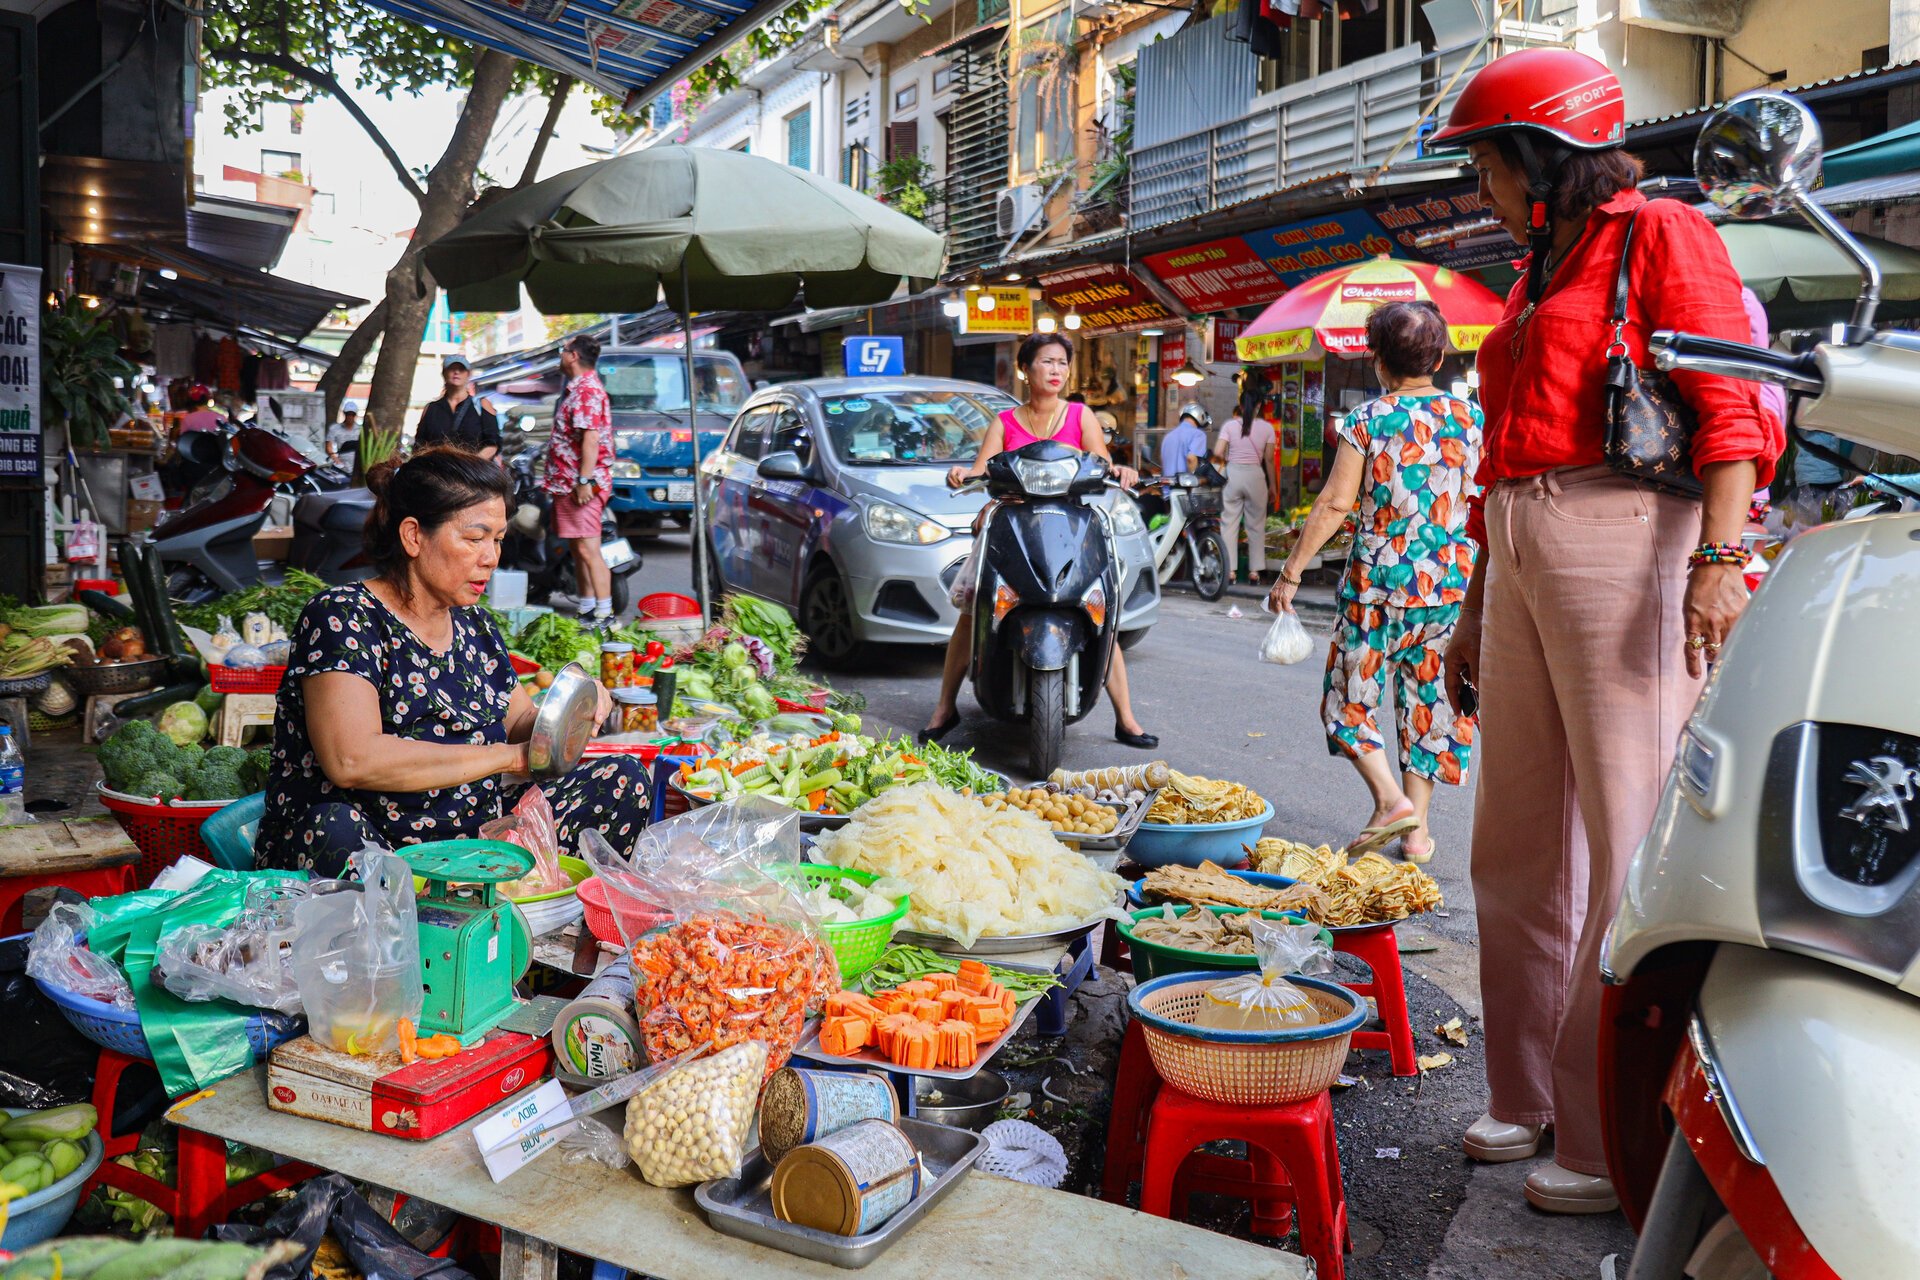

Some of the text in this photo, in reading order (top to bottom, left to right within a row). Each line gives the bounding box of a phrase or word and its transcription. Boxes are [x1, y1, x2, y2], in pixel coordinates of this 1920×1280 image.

[1565, 86, 1606, 111] SPORT
[1305, 221, 1344, 240] LONG
[1266, 255, 1306, 274] HOA
[1329, 242, 1364, 262] CAO
[1189, 270, 1231, 296] QUAY
[1343, 287, 1415, 297] Cholimex
[1325, 334, 1369, 347] CHOLI
[23, 436, 37, 453] BÈ
[311, 1092, 366, 1111] OATMEAL
[517, 1103, 538, 1123] BIDV
